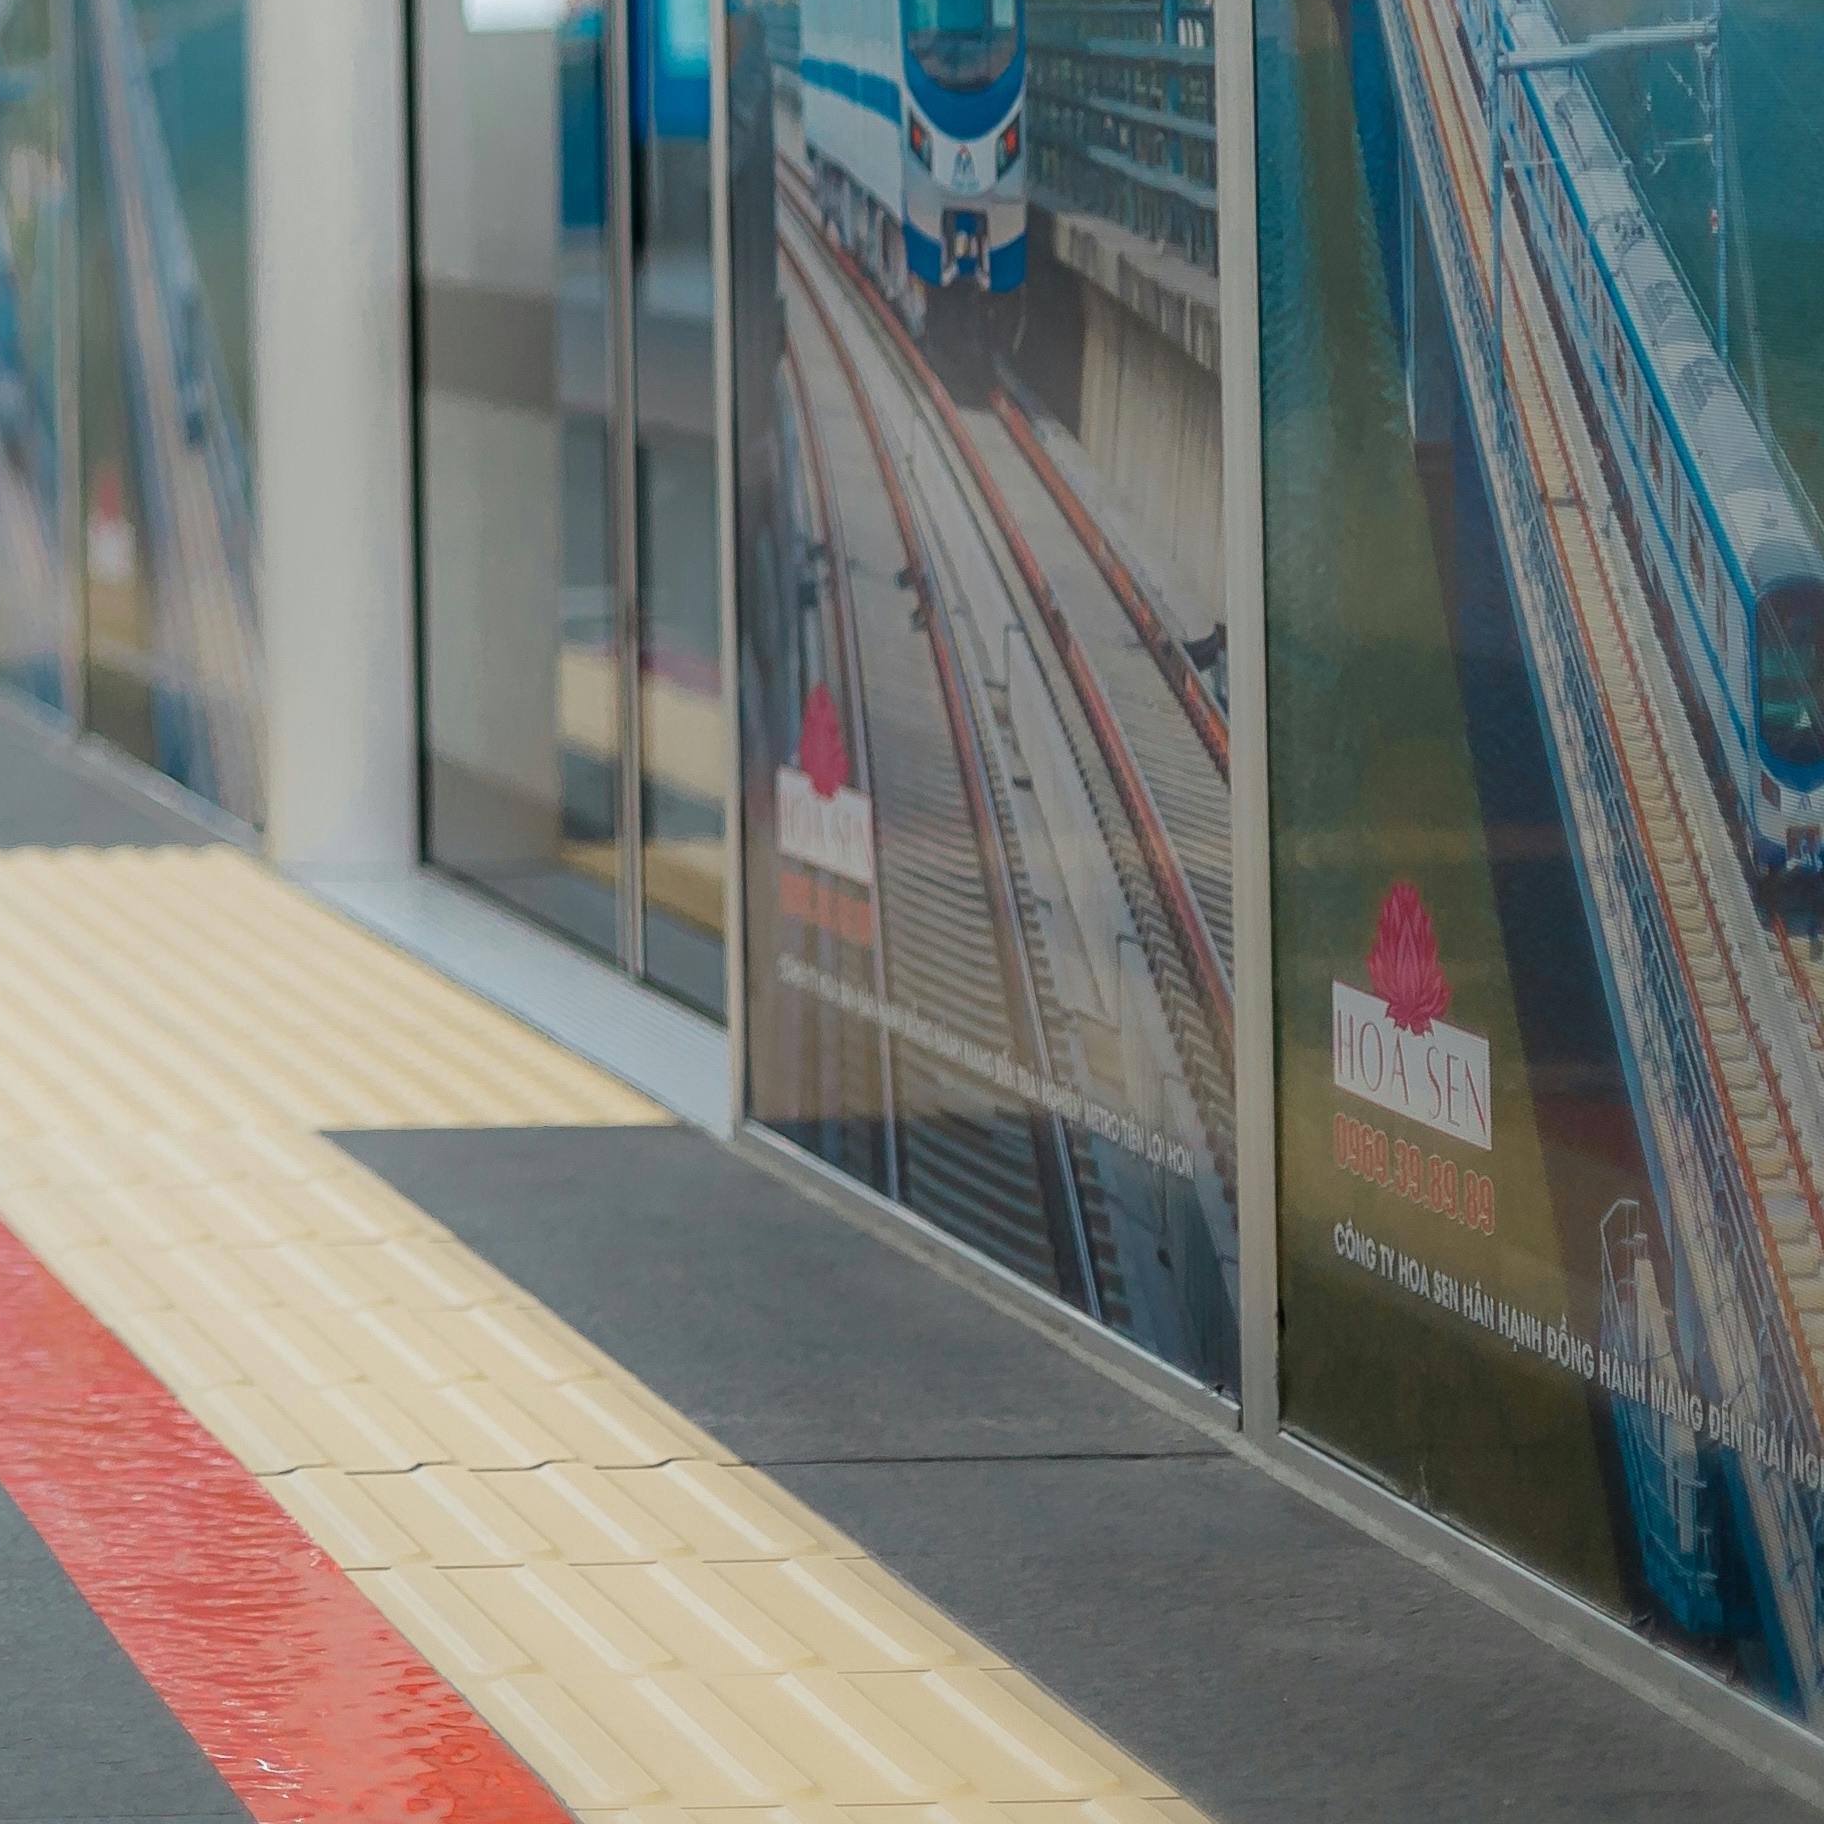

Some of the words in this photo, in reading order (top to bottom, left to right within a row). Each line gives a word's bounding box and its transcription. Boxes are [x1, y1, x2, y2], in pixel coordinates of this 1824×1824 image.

[1335, 1008, 1409, 1107] HOA
[1425, 1044, 1488, 1138] SEN
[1334, 1216, 1377, 1272] CÔNG
[1379, 1242, 1396, 1281] TY
[1398, 1255, 1431, 1300] HOA
[1432, 1270, 1460, 1313] SEN
[1462, 1280, 1494, 1331] HÂN
[1498, 1301, 1542, 1353] HẠNH
[1599, 1346, 1647, 1405] HÀNH
[1651, 1376, 1704, 1433] MANG
